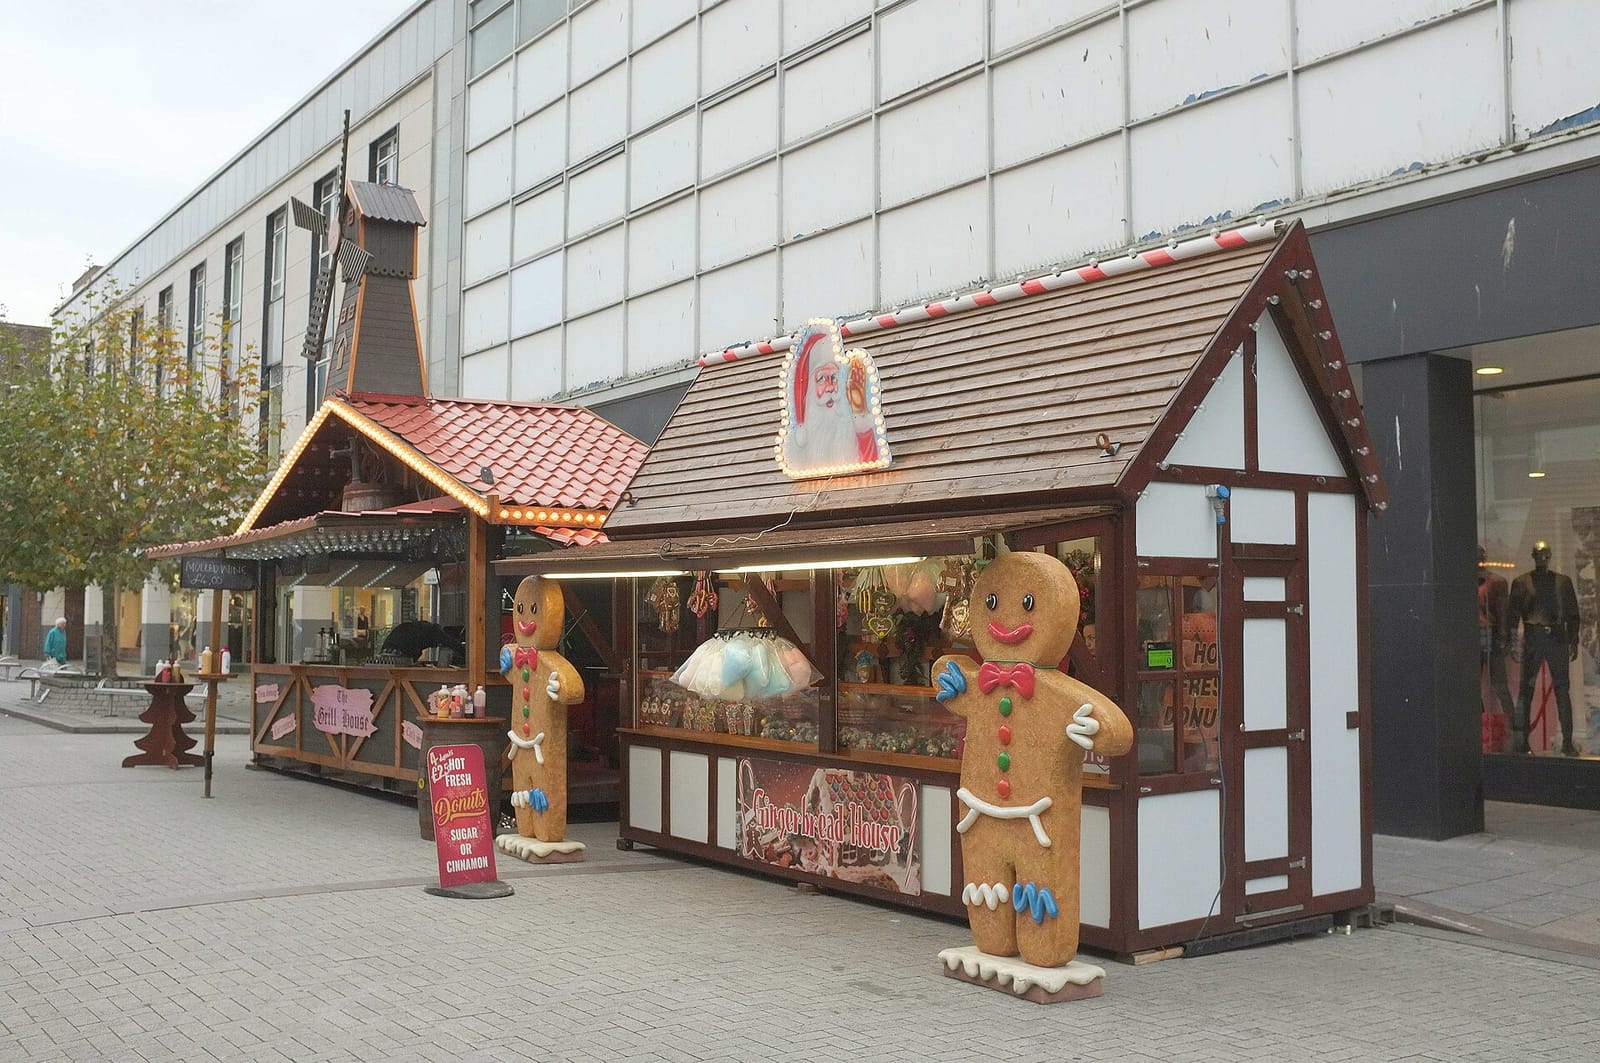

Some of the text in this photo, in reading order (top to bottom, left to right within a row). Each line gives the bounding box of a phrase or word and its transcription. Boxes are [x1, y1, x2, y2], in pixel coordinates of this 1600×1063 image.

[337, 689, 348, 705] The
[317, 705, 370, 731] Grill House
[448, 757, 465, 770] HOT
[445, 773, 472, 787] FRESH
[434, 787, 487, 826] Donuts
[753, 788, 900, 854] Gingerbread House
[450, 827, 478, 841] SUGAR
[459, 843, 472, 856] OR
[446, 856, 489, 873] CINNAMON
